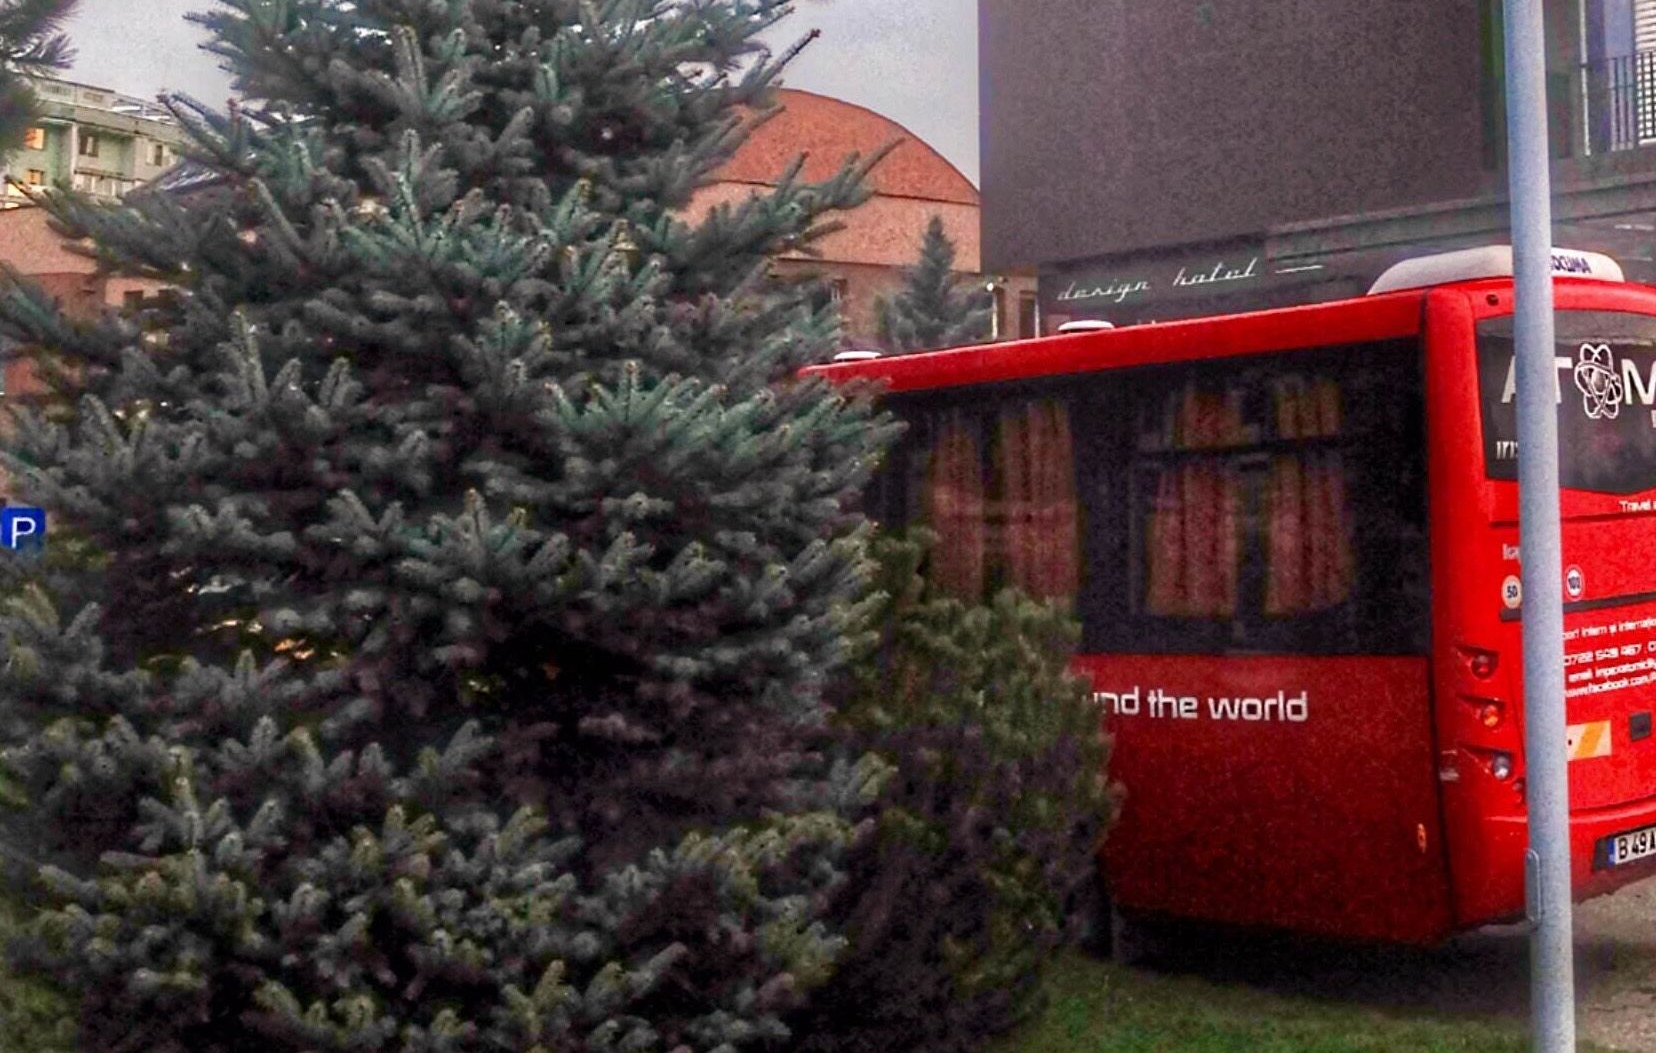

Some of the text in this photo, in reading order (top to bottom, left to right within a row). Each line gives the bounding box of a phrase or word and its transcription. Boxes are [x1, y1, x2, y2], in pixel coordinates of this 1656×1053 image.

[1056, 257, 1258, 304] design hotel
[1619, 499, 1652, 513] Travel
[11, 516, 37, 549] P
[1093, 685, 1309, 722] nd the world
